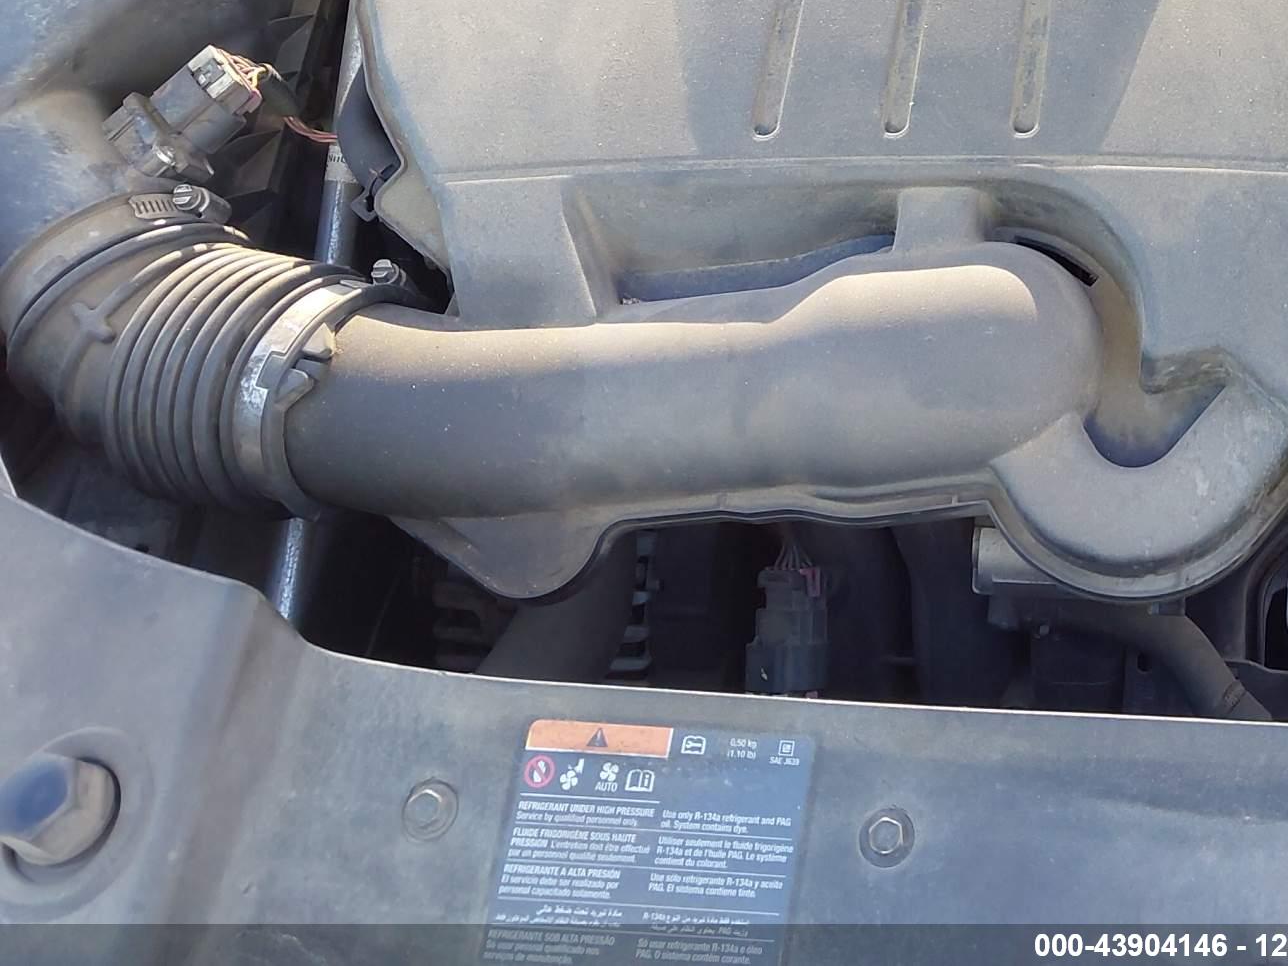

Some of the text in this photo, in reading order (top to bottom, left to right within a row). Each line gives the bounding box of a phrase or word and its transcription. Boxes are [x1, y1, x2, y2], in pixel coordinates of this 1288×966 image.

[769, 756, 782, 765] SAE
[595, 781, 618, 793] AUTO
[518, 800, 656, 818] REFRIGERANT UNDER HIGH PRESSURE
[516, 810, 543, 821] Service
[544, 812, 553, 823] by
[662, 809, 792, 827] Use only R-134a refrigerant and PAG
[673, 820, 701, 832] System
[701, 822, 732, 833] contains
[733, 825, 749, 835] dye.
[590, 831, 610, 842] SOUS
[611, 832, 637, 843] HAUTE
[656, 845, 683, 856] R-134a
[684, 847, 692, 857] et
[692, 848, 704, 857] de
[745, 851, 755, 861] Le
[654, 856, 684, 867] contient
[685, 857, 696, 867] du
[503, 863, 560, 876] REFRIGERANTE
[560, 866, 567, 876] A
[567, 866, 586, 878] ALTA
[501, 873, 509, 883] El
[650, 872, 665, 883] Use
[682, 875, 725, 887] refrigerante
[726, 876, 753, 888] R-134a
[754, 880, 760, 890] y
[666, 883, 675, 893] El
[675, 884, 704, 896] sistema
[705, 886, 737, 897] contiene
[560, 933, 580, 944] ALTA
[711, 942, 740, 954] R-134a
